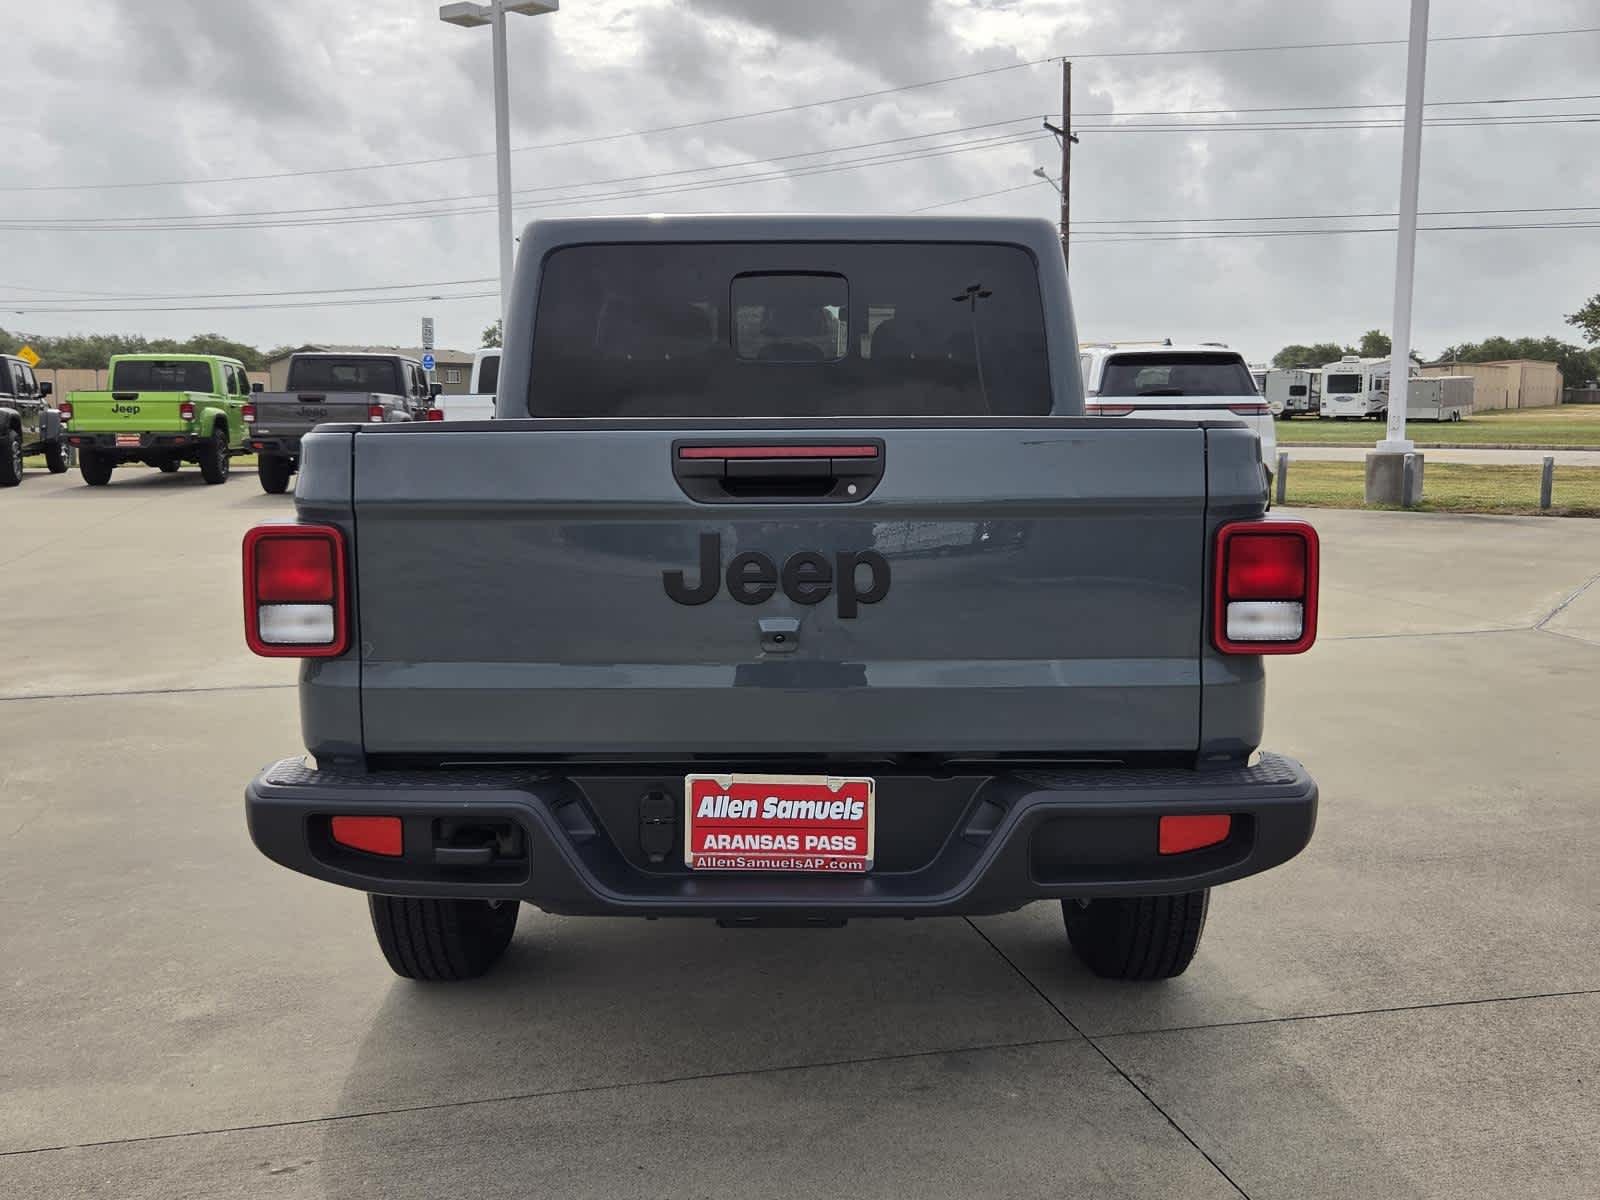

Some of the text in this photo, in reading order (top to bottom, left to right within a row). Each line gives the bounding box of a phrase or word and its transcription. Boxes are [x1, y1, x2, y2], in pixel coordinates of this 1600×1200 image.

[112, 403, 140, 415] Jeep
[662, 532, 891, 619] Jeep
[697, 796, 865, 821] Allen Samuels
[703, 834, 857, 851] ARANSAS PASS
[696, 856, 863, 871] AllenSamuelsAP.com
